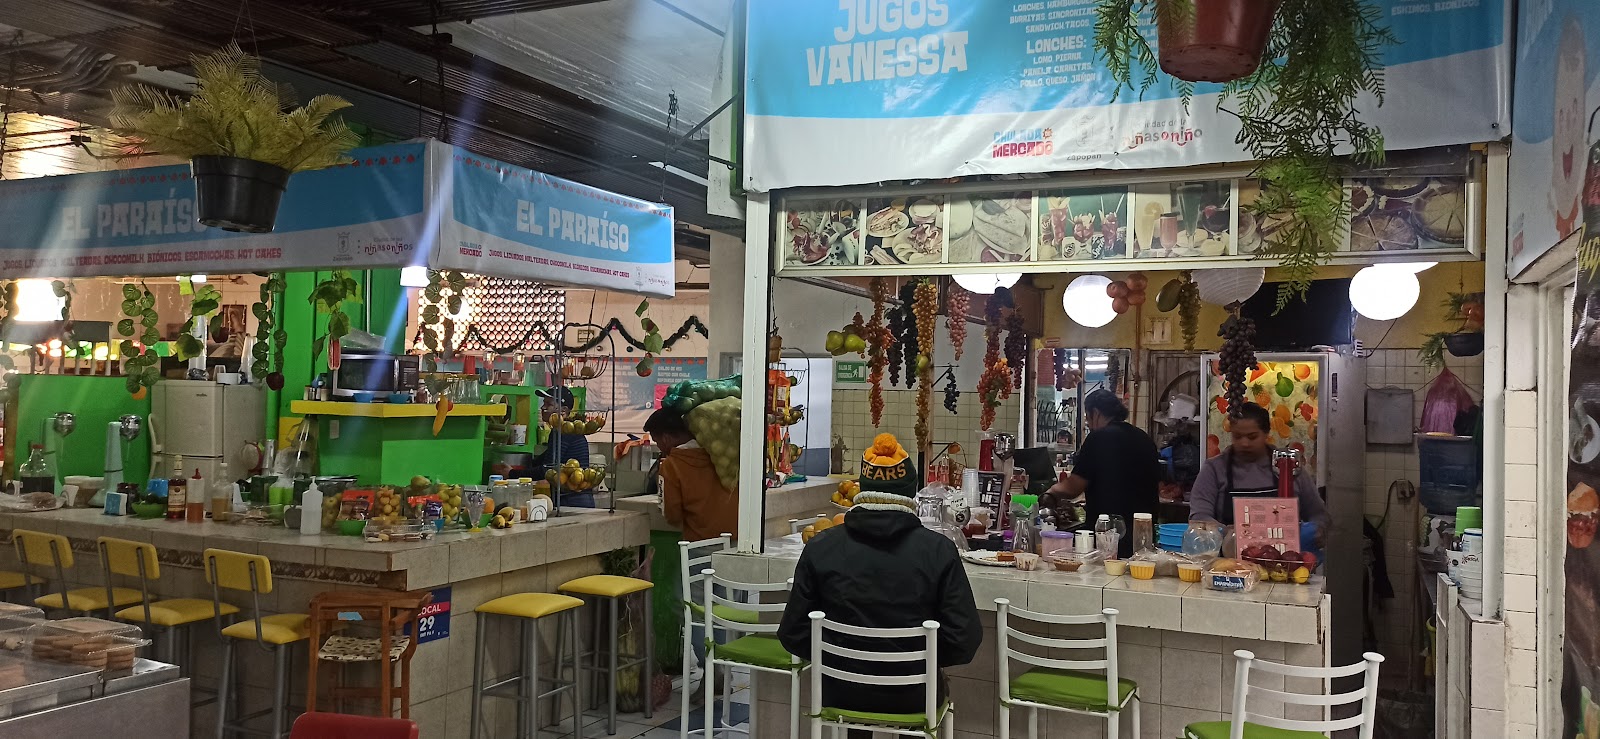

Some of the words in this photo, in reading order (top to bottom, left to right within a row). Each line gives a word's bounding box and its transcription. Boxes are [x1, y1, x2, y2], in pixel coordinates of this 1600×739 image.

[834, 0, 949, 42] JUGOS
[1026, 35, 1087, 54] LONCHES:
[806, 31, 969, 87] VANESSA
[992, 141, 1054, 158] MERCADO
[61, 206, 91, 240] EL
[516, 199, 543, 236] EL
[548, 206, 629, 253] PARAÍSO
[238, 248, 253, 259] HOT
[255, 247, 282, 259] CAKES
[862, 462, 907, 480] BEARS
[419, 615, 435, 632] 29
